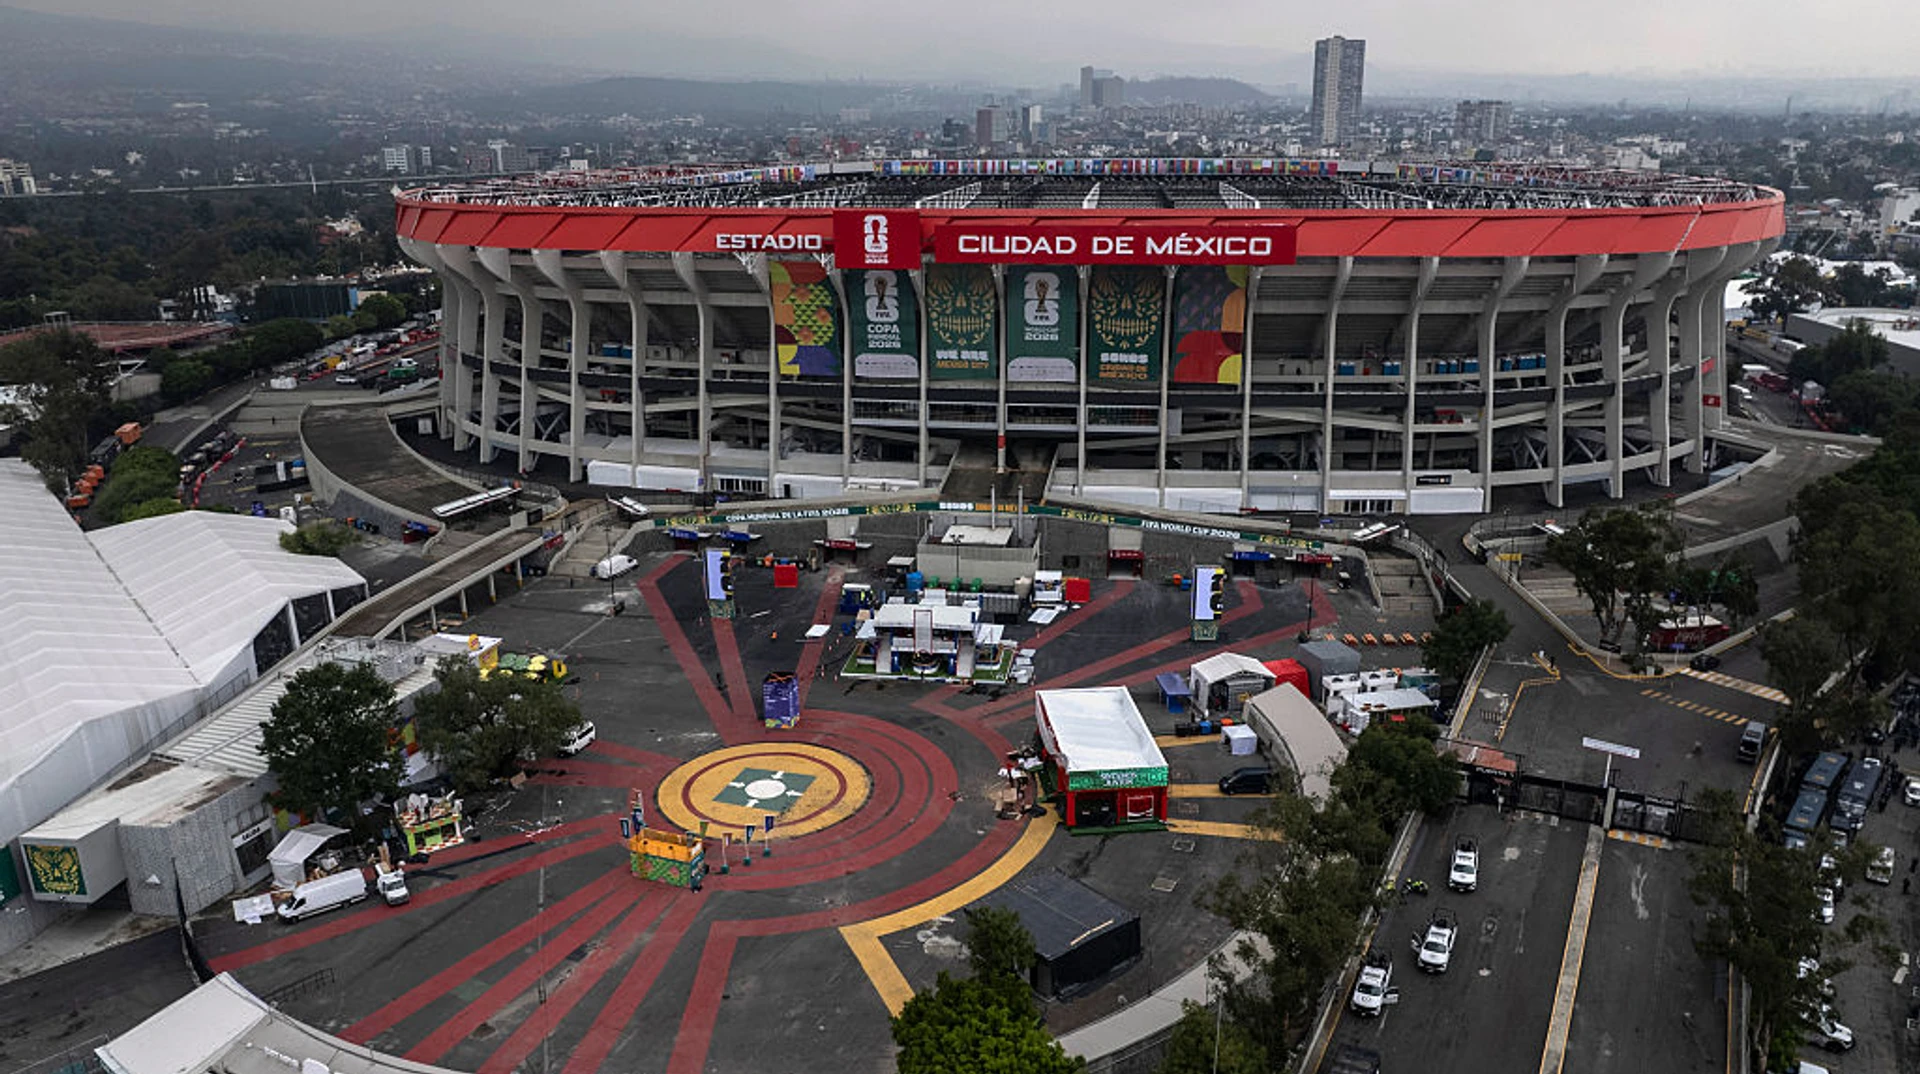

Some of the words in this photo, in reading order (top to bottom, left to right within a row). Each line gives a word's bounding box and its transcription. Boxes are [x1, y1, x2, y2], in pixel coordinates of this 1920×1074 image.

[716, 233, 822, 249] ESTADIO
[958, 235, 1077, 254] CIUDAD
[1091, 236, 1134, 255] DE
[1145, 233, 1273, 256] MÉXICO
[867, 324, 900, 333] COPA
[1141, 519, 1160, 529] FIFA
[1160, 522, 1191, 533] WORLD
[1192, 527, 1209, 535] CUP
